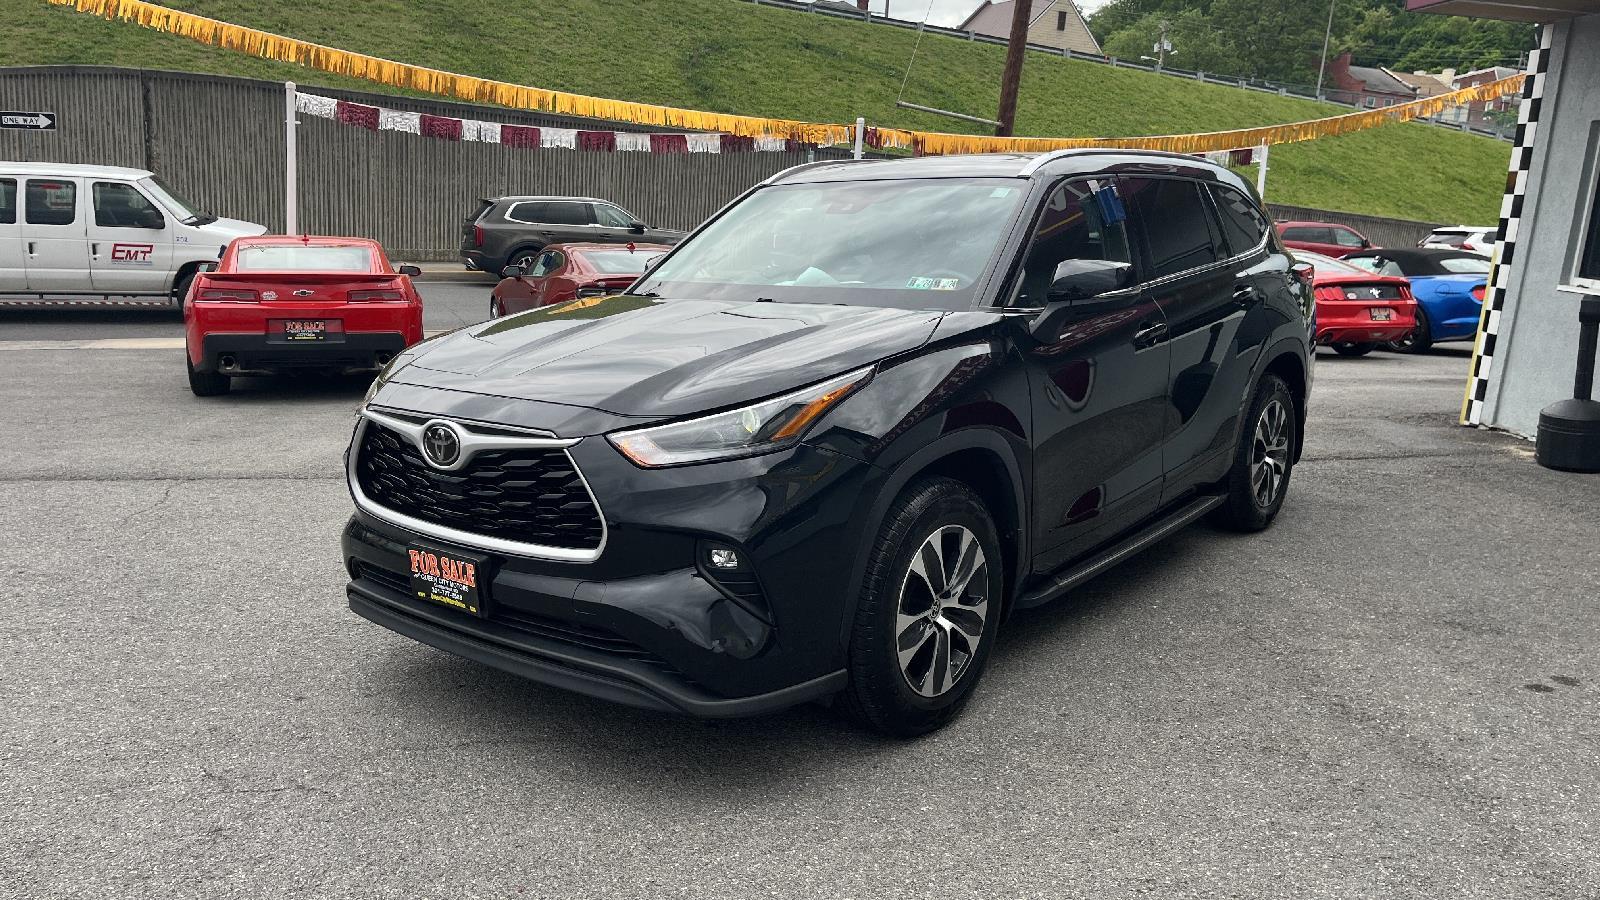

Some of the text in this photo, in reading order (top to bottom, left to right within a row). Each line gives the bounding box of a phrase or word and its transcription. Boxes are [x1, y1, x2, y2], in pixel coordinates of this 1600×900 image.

[3, 116, 39, 125] ONE WAY
[285, 321, 325, 331] FOR SALE
[408, 549, 476, 588] FOR SALE
[438, 577, 450, 586] CITY
